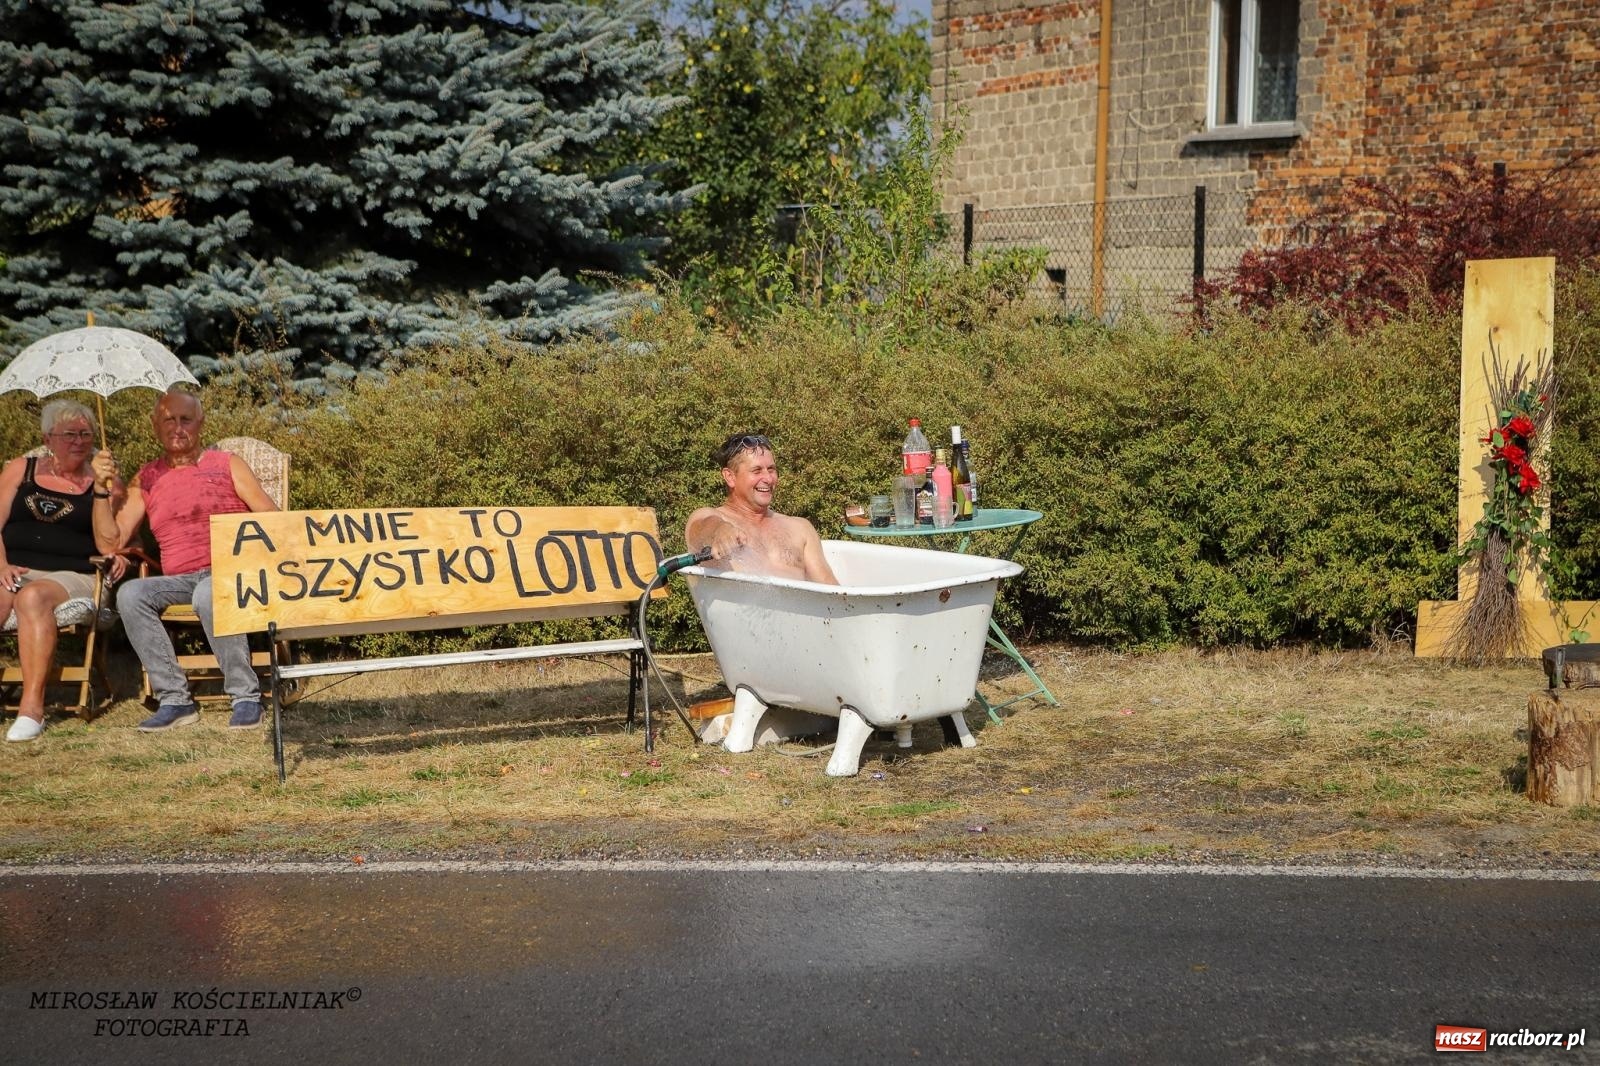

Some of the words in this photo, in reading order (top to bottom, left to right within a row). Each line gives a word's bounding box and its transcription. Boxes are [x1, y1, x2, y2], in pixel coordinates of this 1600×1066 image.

[233, 520, 276, 556] A
[305, 511, 419, 546] MNIE
[459, 509, 522, 538] TO
[236, 545, 495, 609] WSZYSTKO
[506, 529, 666, 598] LOTTO
